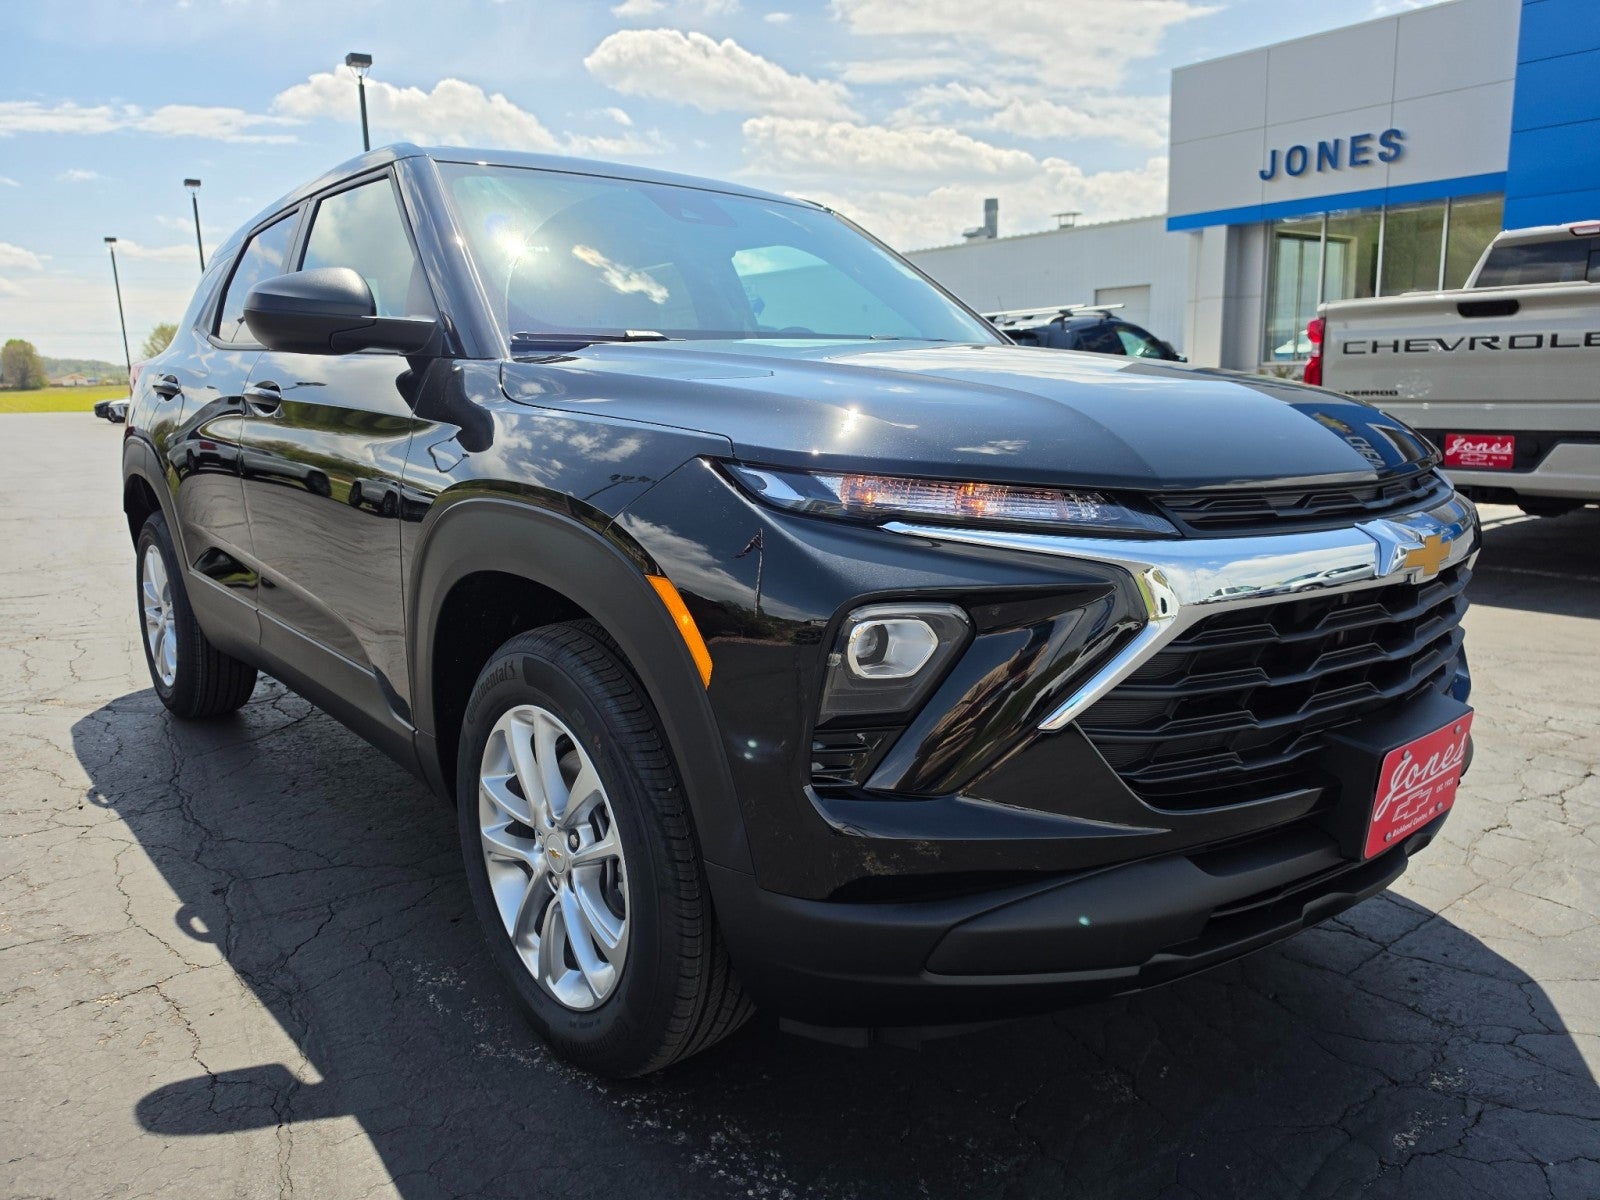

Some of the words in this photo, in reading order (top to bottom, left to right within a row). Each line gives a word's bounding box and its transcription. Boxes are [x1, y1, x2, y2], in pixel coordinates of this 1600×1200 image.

[1259, 128, 1404, 180] JONES
[1446, 438, 1512, 455] Jones
[1374, 733, 1466, 822] Jones
